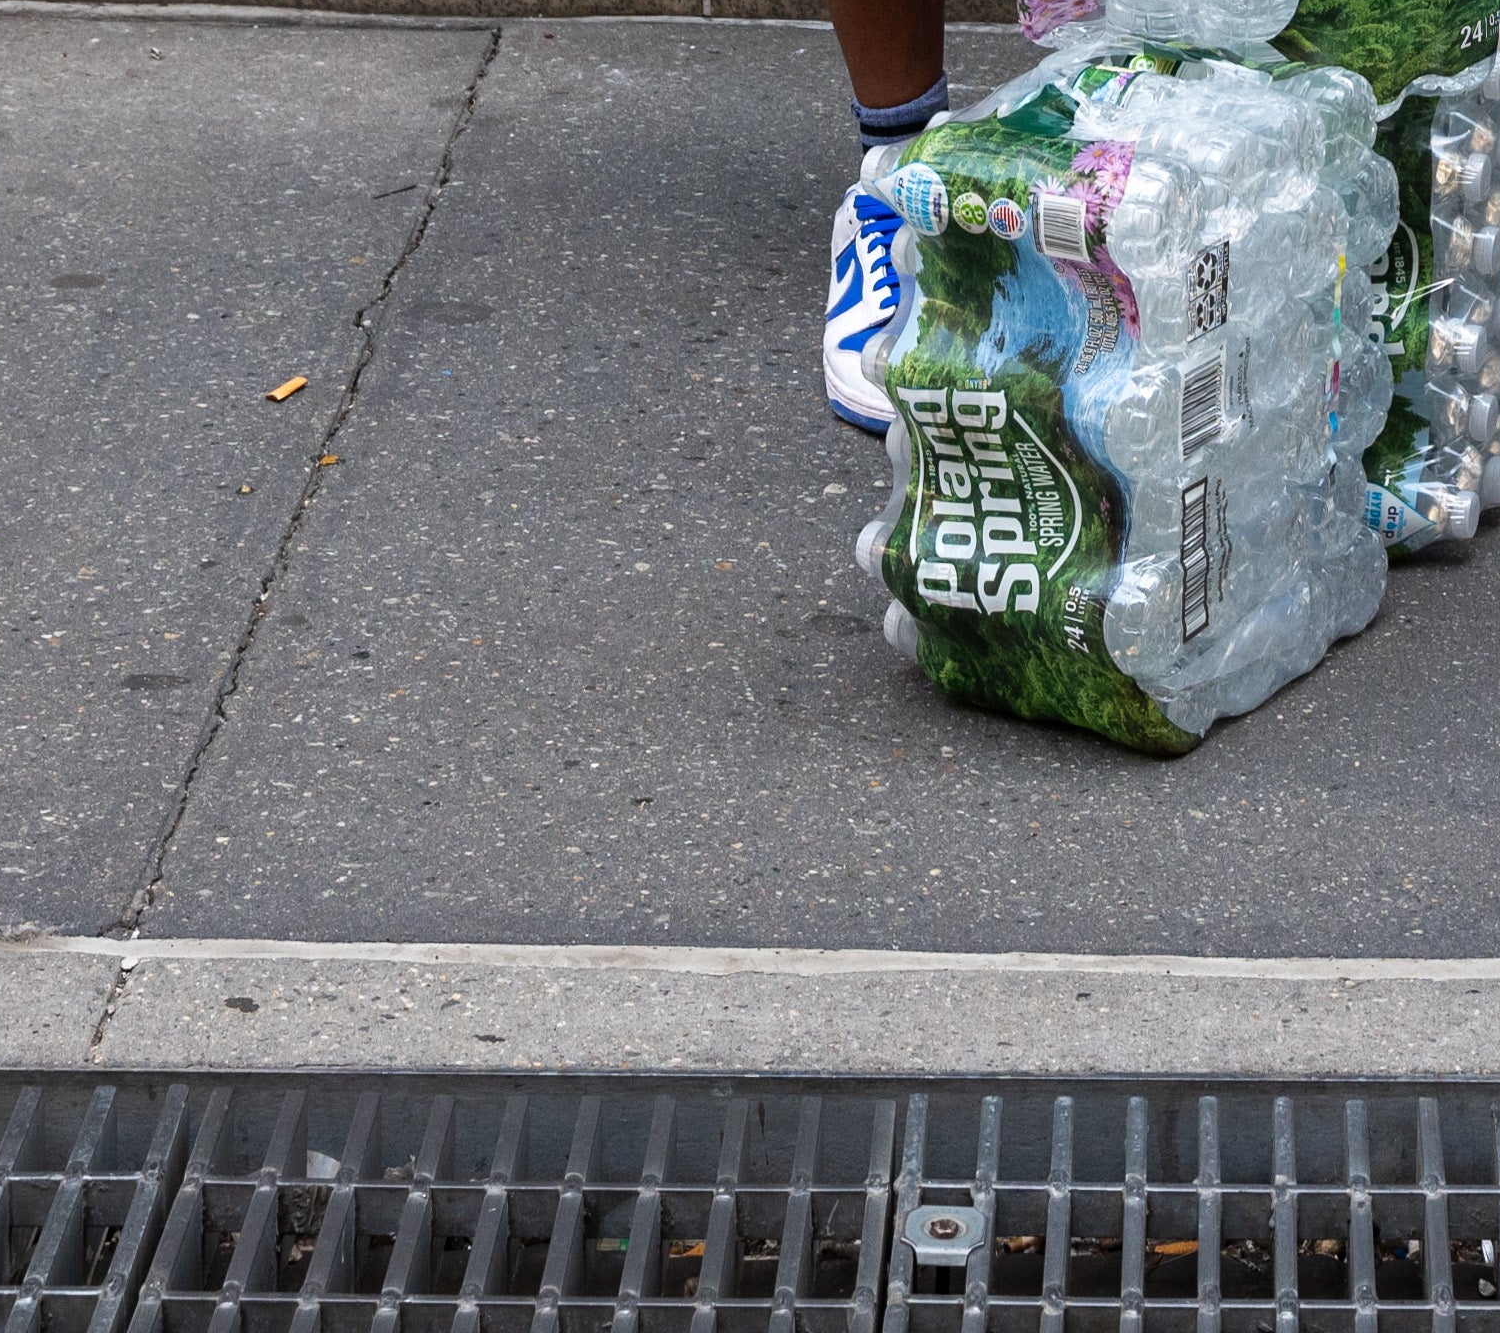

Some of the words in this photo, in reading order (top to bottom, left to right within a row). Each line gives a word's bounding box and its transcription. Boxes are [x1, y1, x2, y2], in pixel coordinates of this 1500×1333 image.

[1459, 19, 1483, 50] 24
[1395, 255, 1407, 285] 1845
[1099, 329, 1118, 353] TOTAL
[1073, 347, 1098, 374] 24-16.9
[925, 448, 937, 481] 1845
[1011, 452, 1034, 501] NATURAL
[1015, 441, 1056, 489] WATER
[896, 385, 982, 614] Poland
[951, 387, 1041, 617] Spring
[1027, 505, 1038, 534] 100%
[1034, 490, 1065, 548] SPRING
[1386, 505, 1398, 539] drop
[1064, 585, 1082, 614] 0.5
[1079, 587, 1092, 616] LITER
[1063, 622, 1090, 656] 24
